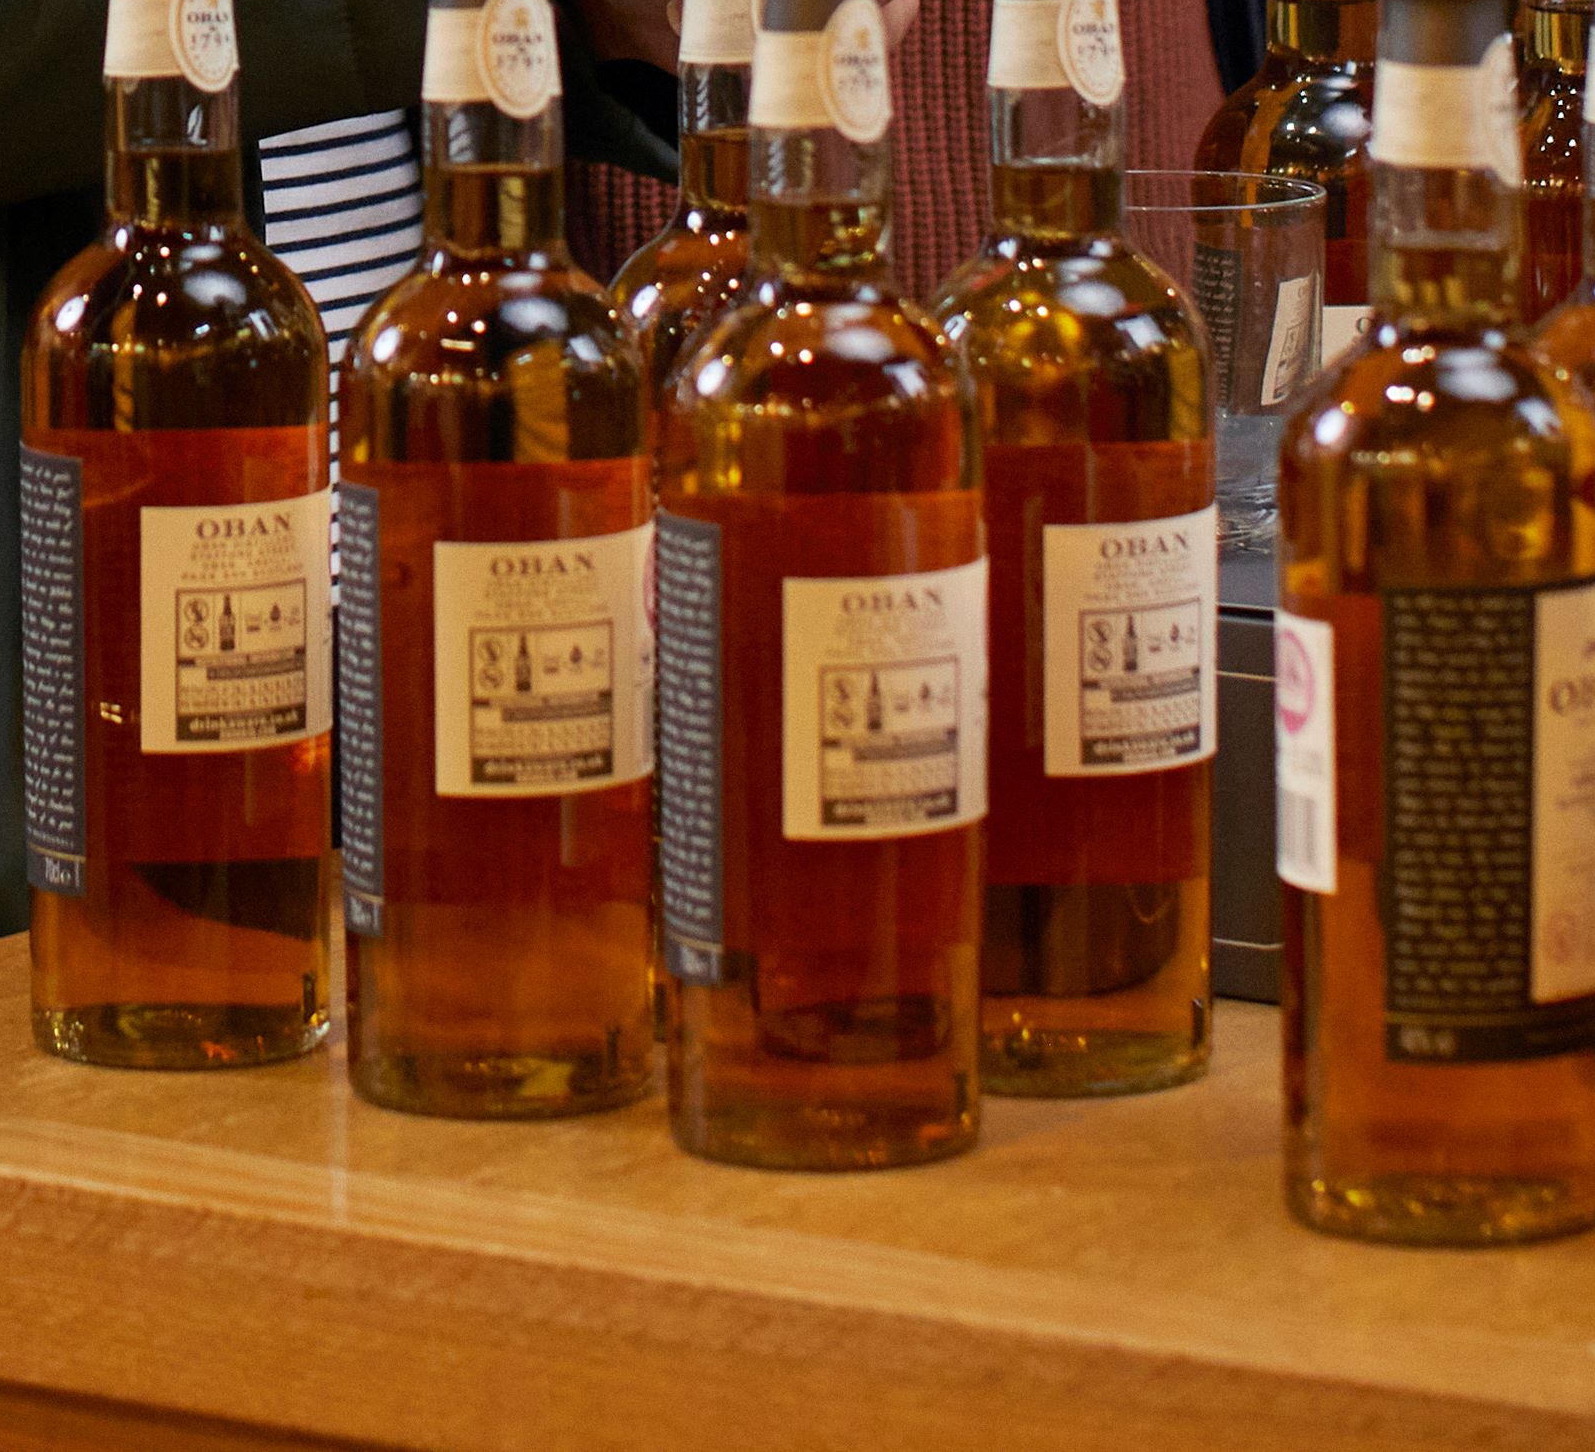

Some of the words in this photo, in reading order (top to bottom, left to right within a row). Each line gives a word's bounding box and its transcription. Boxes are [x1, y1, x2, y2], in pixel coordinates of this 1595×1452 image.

[186, 11, 230, 24] OBAN
[195, 511, 293, 540] OBAN
[1099, 531, 1191, 560] OBAN
[489, 551, 596, 576] OBAN
[842, 588, 941, 615] OBAN
